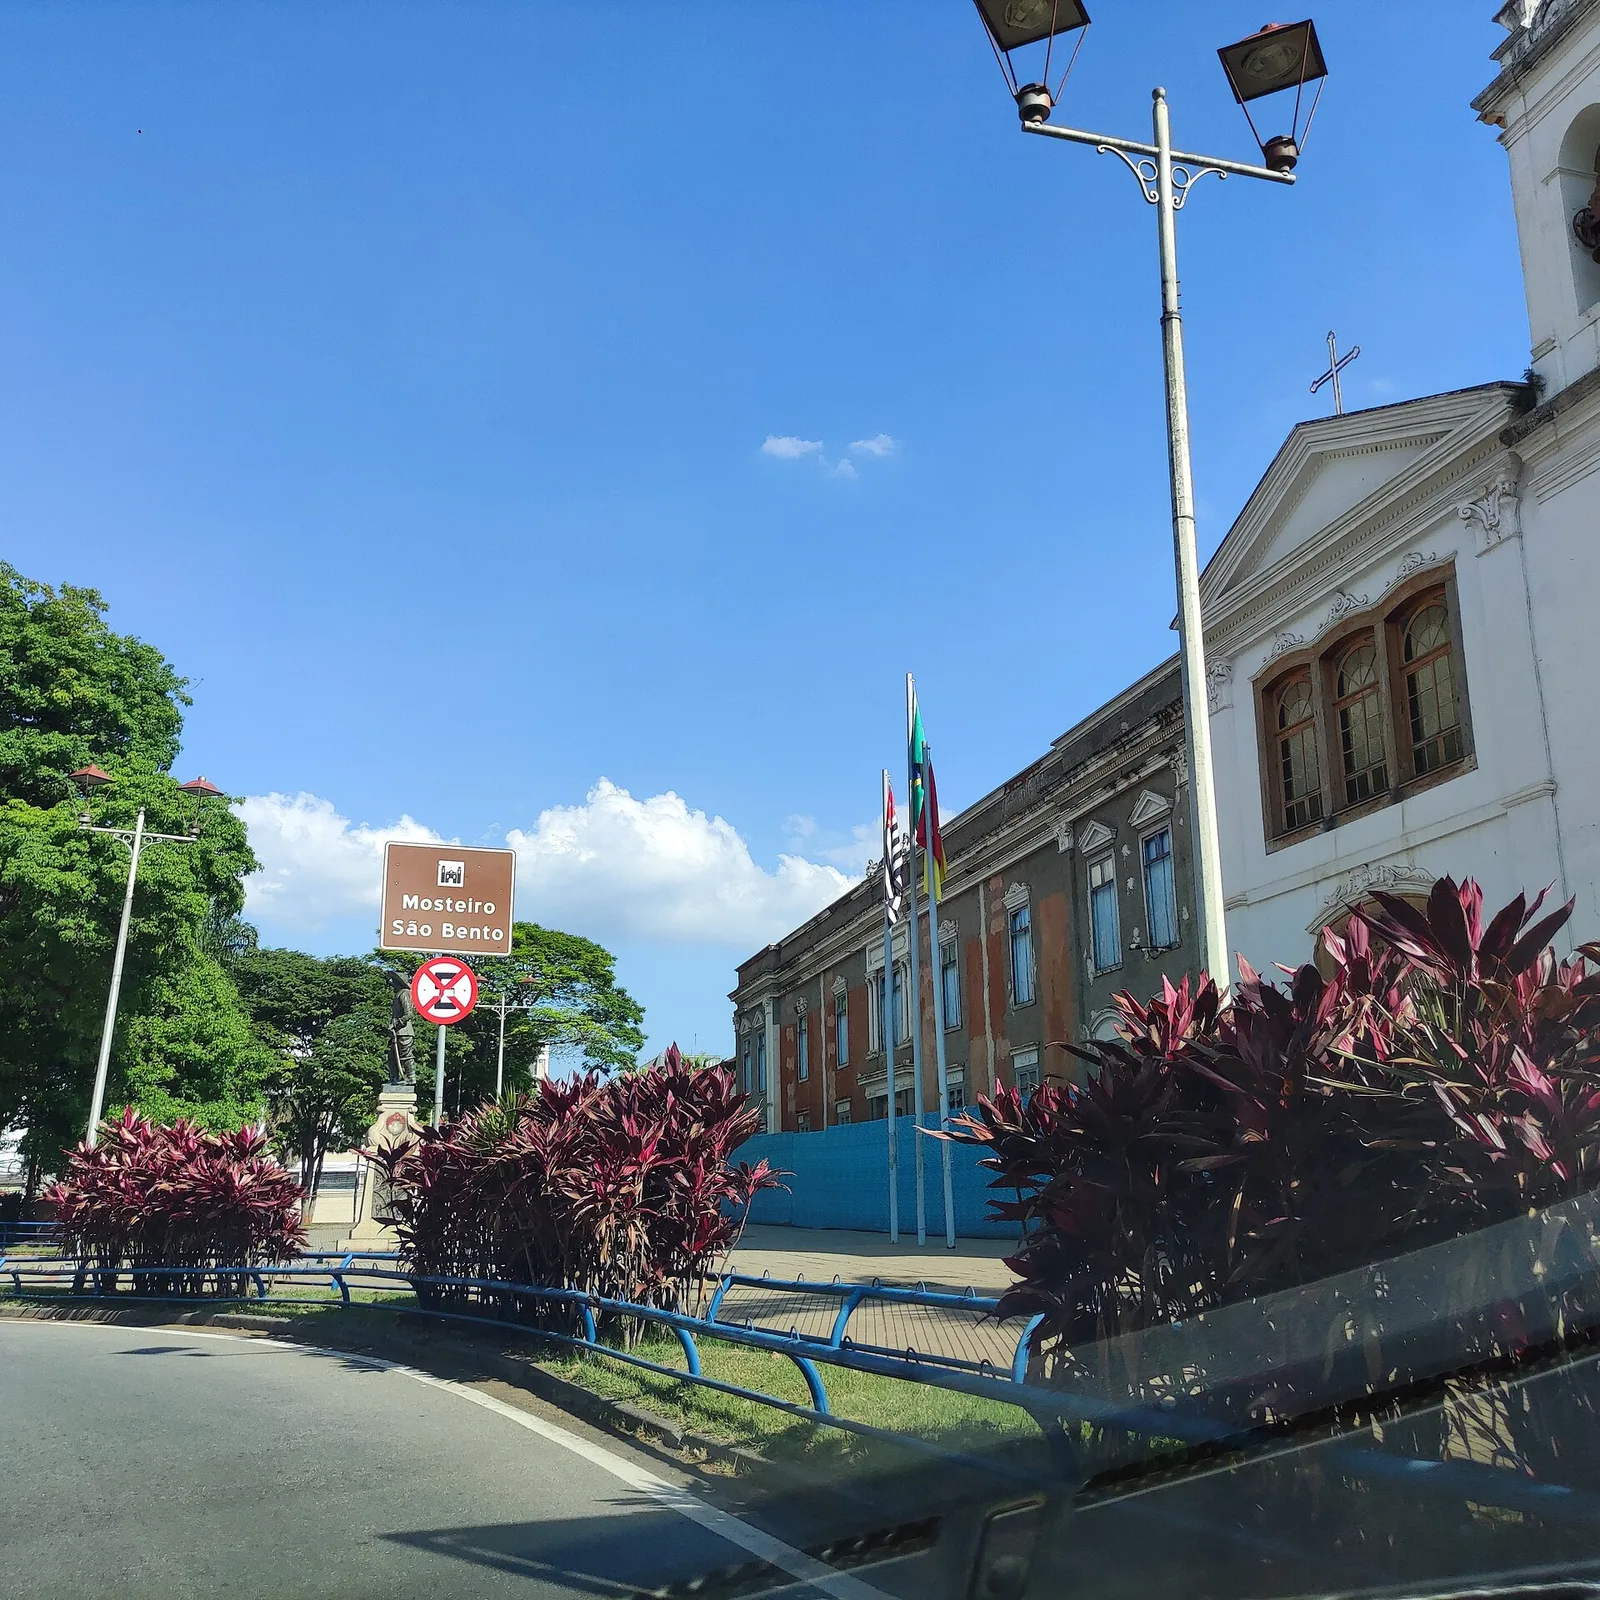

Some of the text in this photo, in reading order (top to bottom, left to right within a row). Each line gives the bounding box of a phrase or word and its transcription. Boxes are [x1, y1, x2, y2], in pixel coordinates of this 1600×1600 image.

[402, 894, 496, 915] Mosteiro
[392, 919, 504, 941] São Bento
